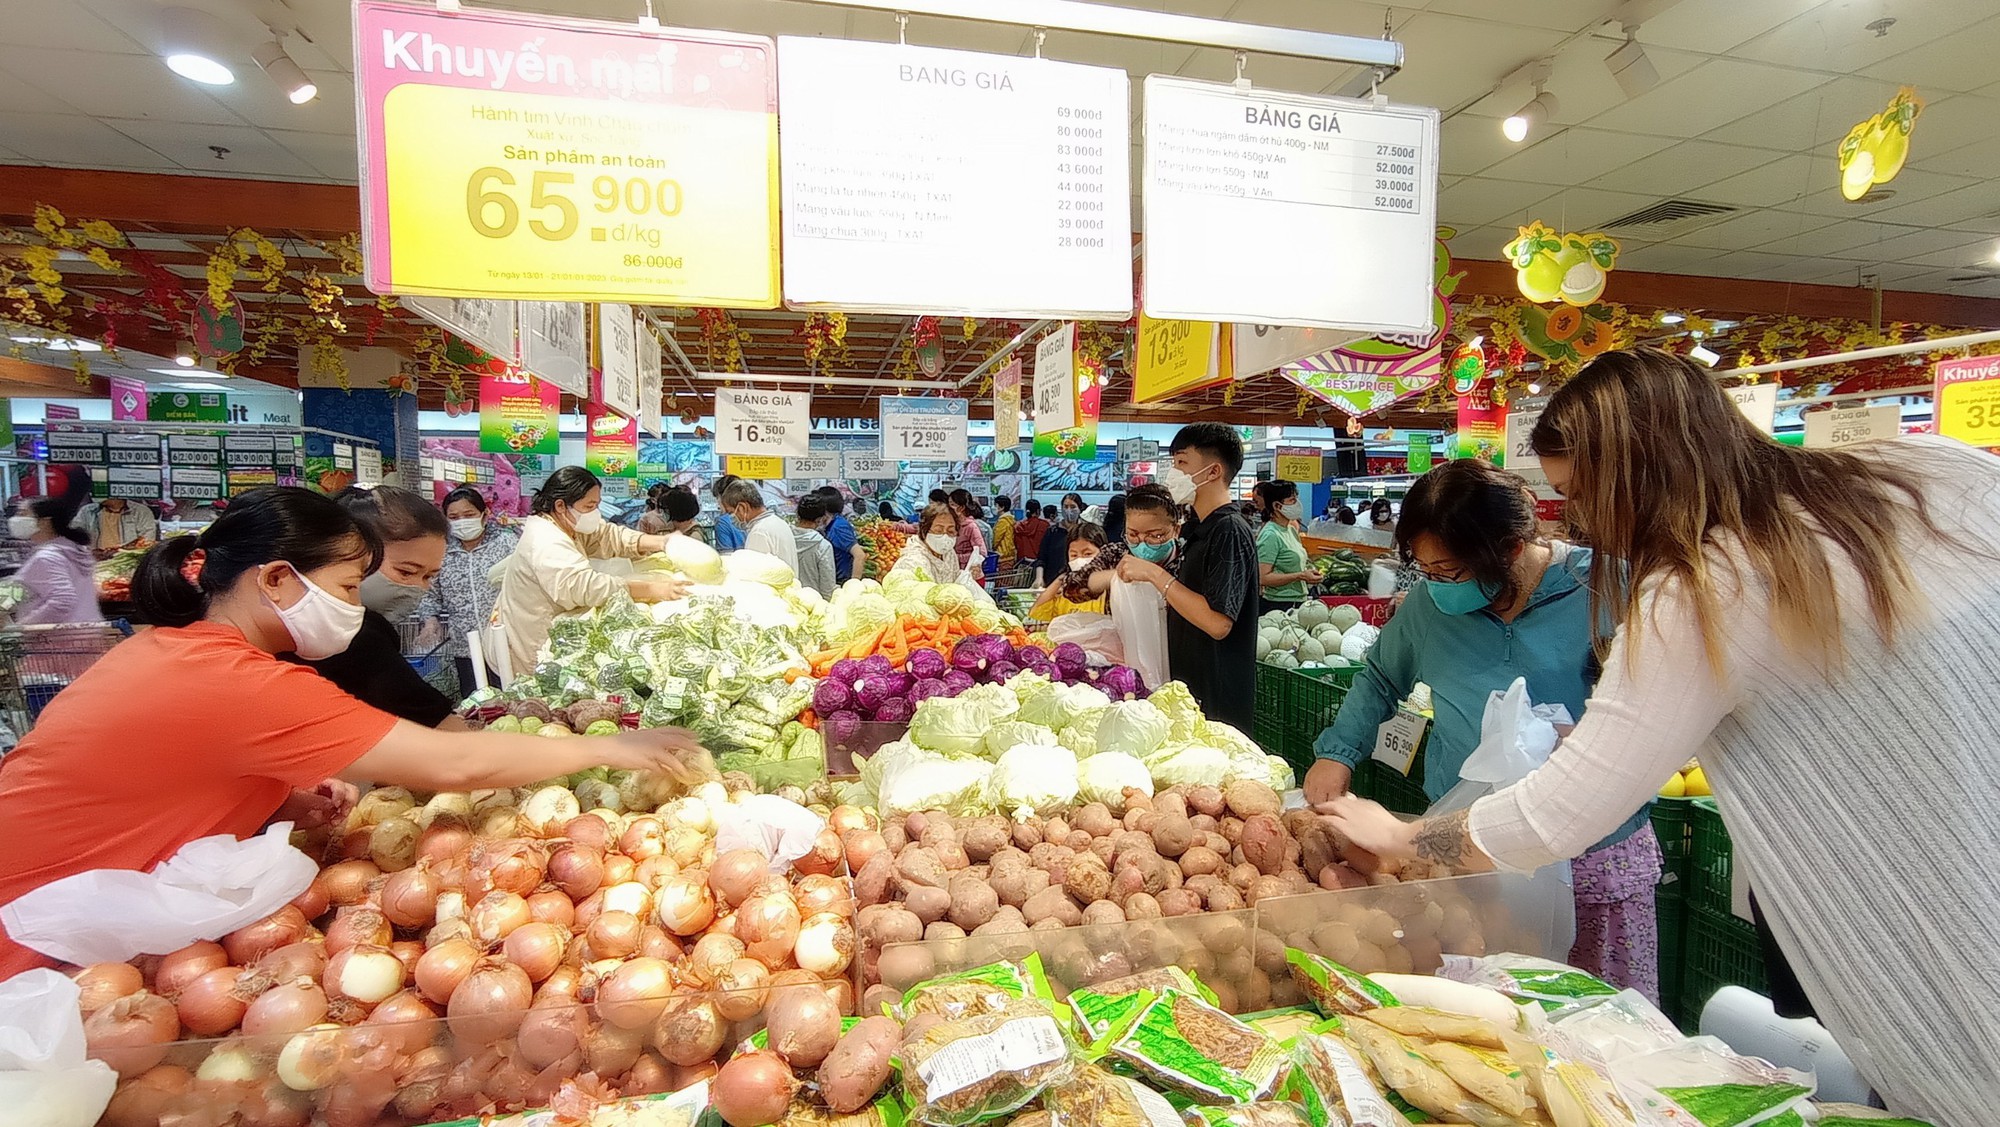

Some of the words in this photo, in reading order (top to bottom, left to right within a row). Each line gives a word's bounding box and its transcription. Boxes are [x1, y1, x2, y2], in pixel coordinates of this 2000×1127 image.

[382, 28, 575, 90] Khuyến
[1245, 105, 1302, 130] BẢNG
[1308, 112, 1342, 134] GIÁ
[1284, 138, 1307, 153] 400g
[1313, 141, 1330, 152] NM
[1376, 145, 1415, 159] 27.500đ
[503, 144, 539, 161] Sản
[545, 147, 595, 166] phẩm
[601, 154, 621, 166] an
[628, 153, 666, 169] toàn
[1223, 166, 1245, 180] 550g
[1253, 169, 1269, 180] NM
[1375, 162, 1414, 176] 52.000đ
[1375, 179, 1413, 192] 39.000đ
[1374, 196, 1413, 209] 52.000đ
[1943, 360, 2000, 381] Khuyế
[1325, 379, 1355, 390] BEST
[1358, 380, 1395, 392] PRICE
[734, 393, 768, 406] BẢNG
[772, 394, 792, 407] GIÁ
[1734, 390, 1756, 405] GIÁ
[264, 413, 291, 423] Meat
